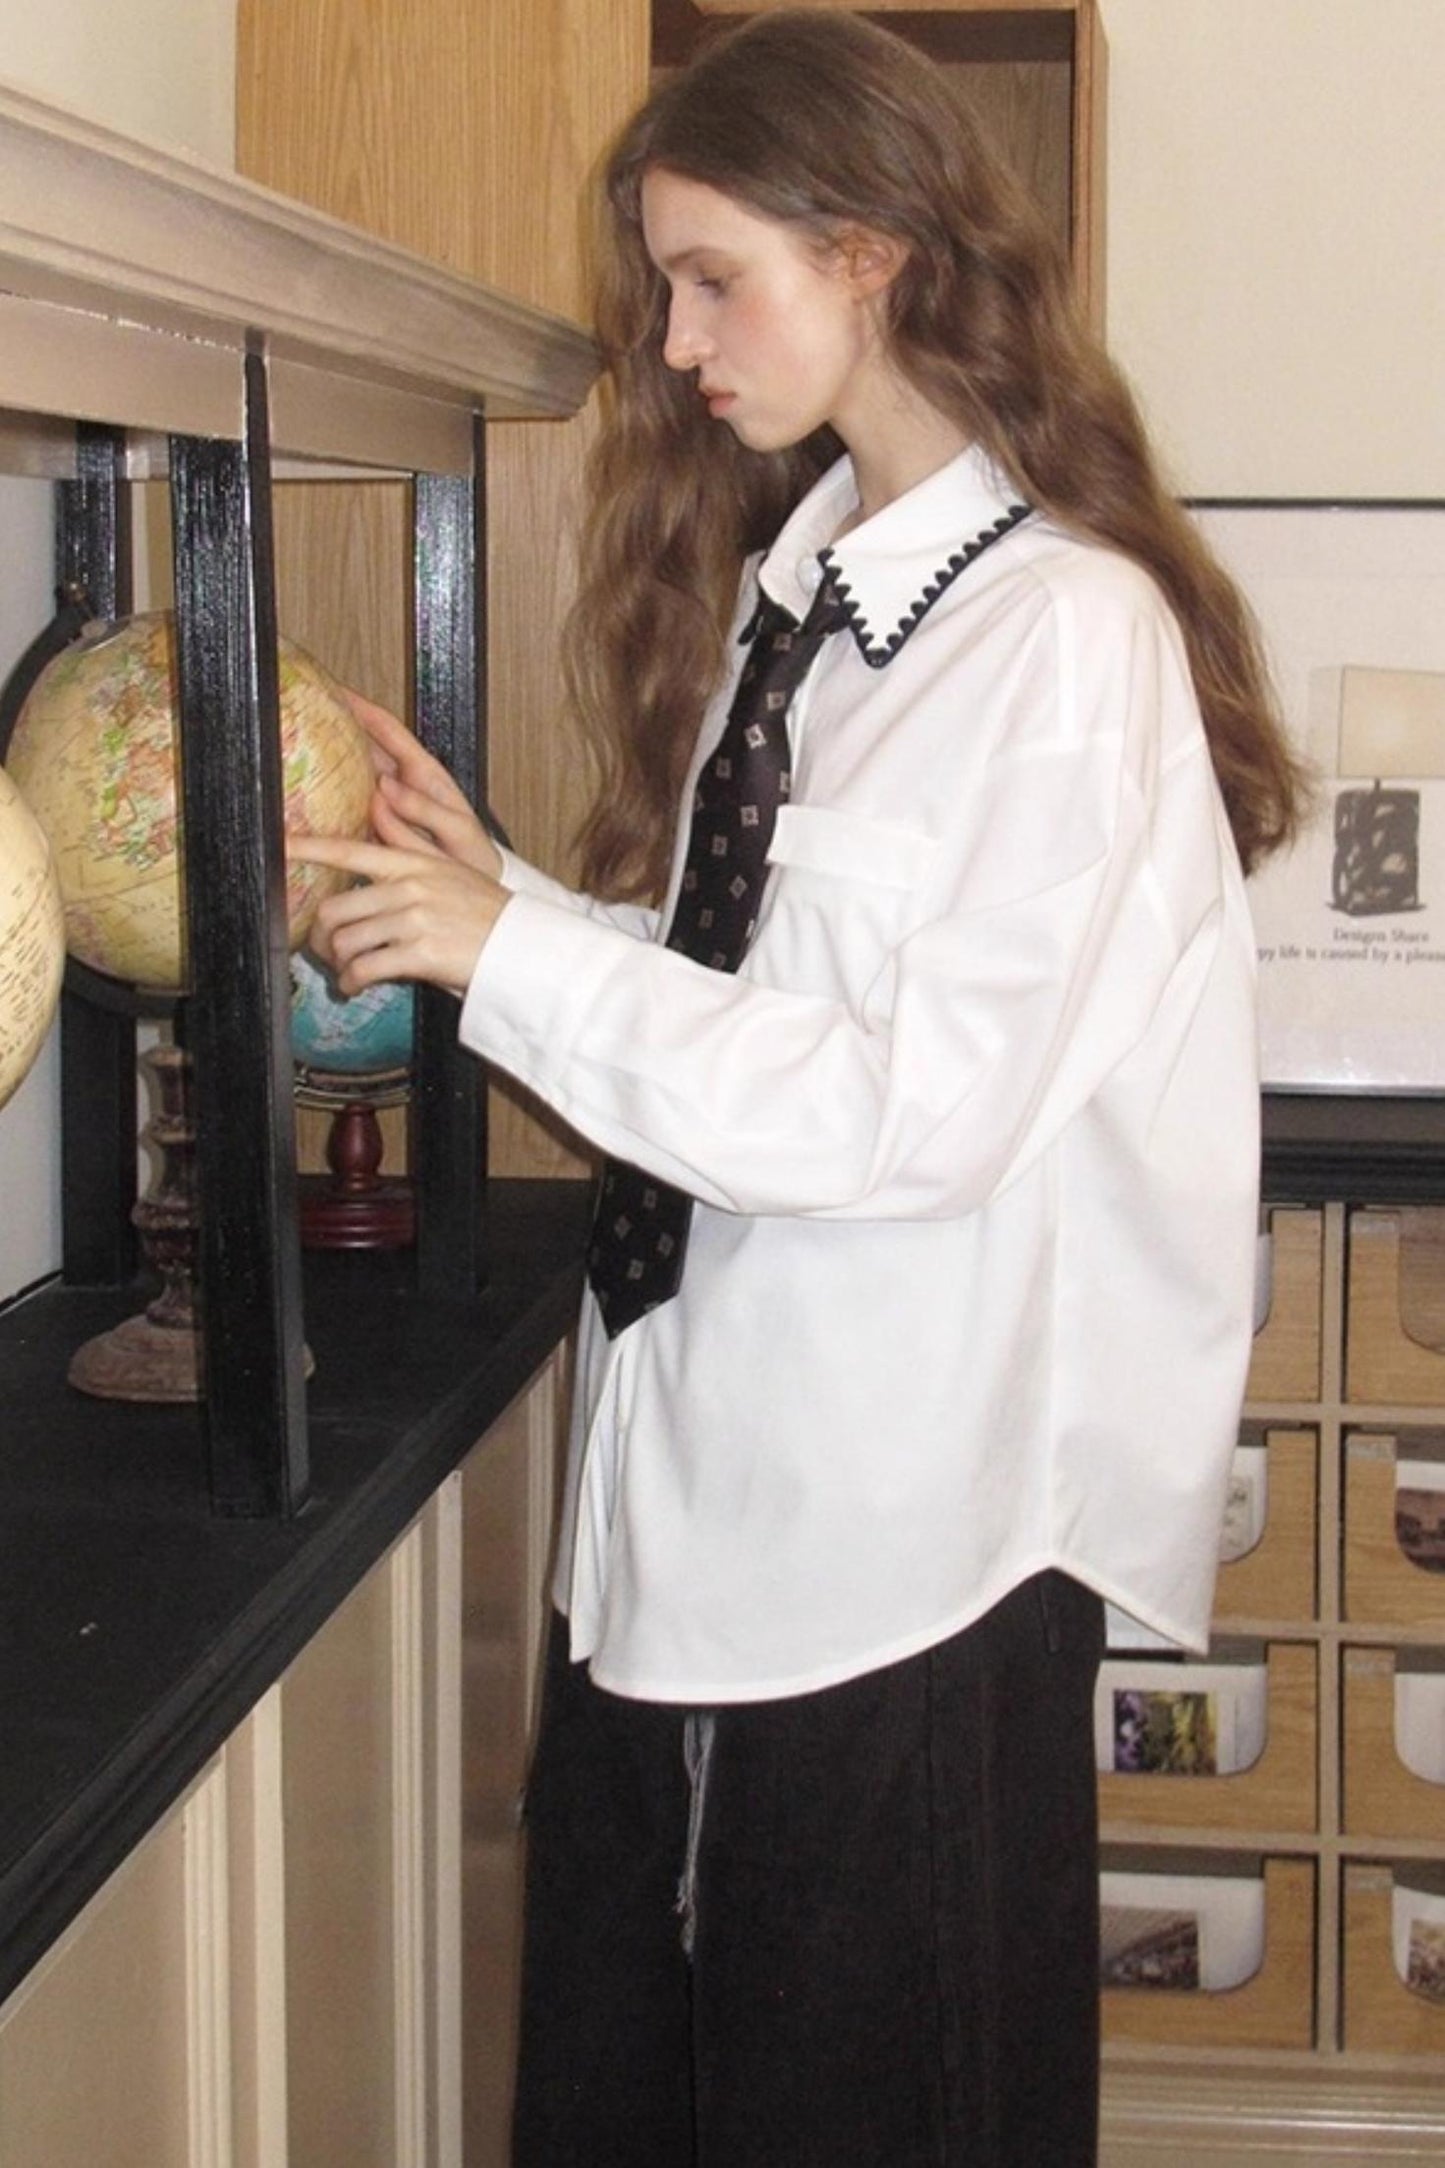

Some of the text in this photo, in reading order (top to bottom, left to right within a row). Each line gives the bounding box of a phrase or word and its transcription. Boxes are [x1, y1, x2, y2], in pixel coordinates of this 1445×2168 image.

[1391, 928, 1429, 943] Share
[1279, 945, 1301, 959] life
[1306, 945, 1316, 960] is
[1372, 946, 1389, 964] by
[1393, 950, 1402, 961] a
